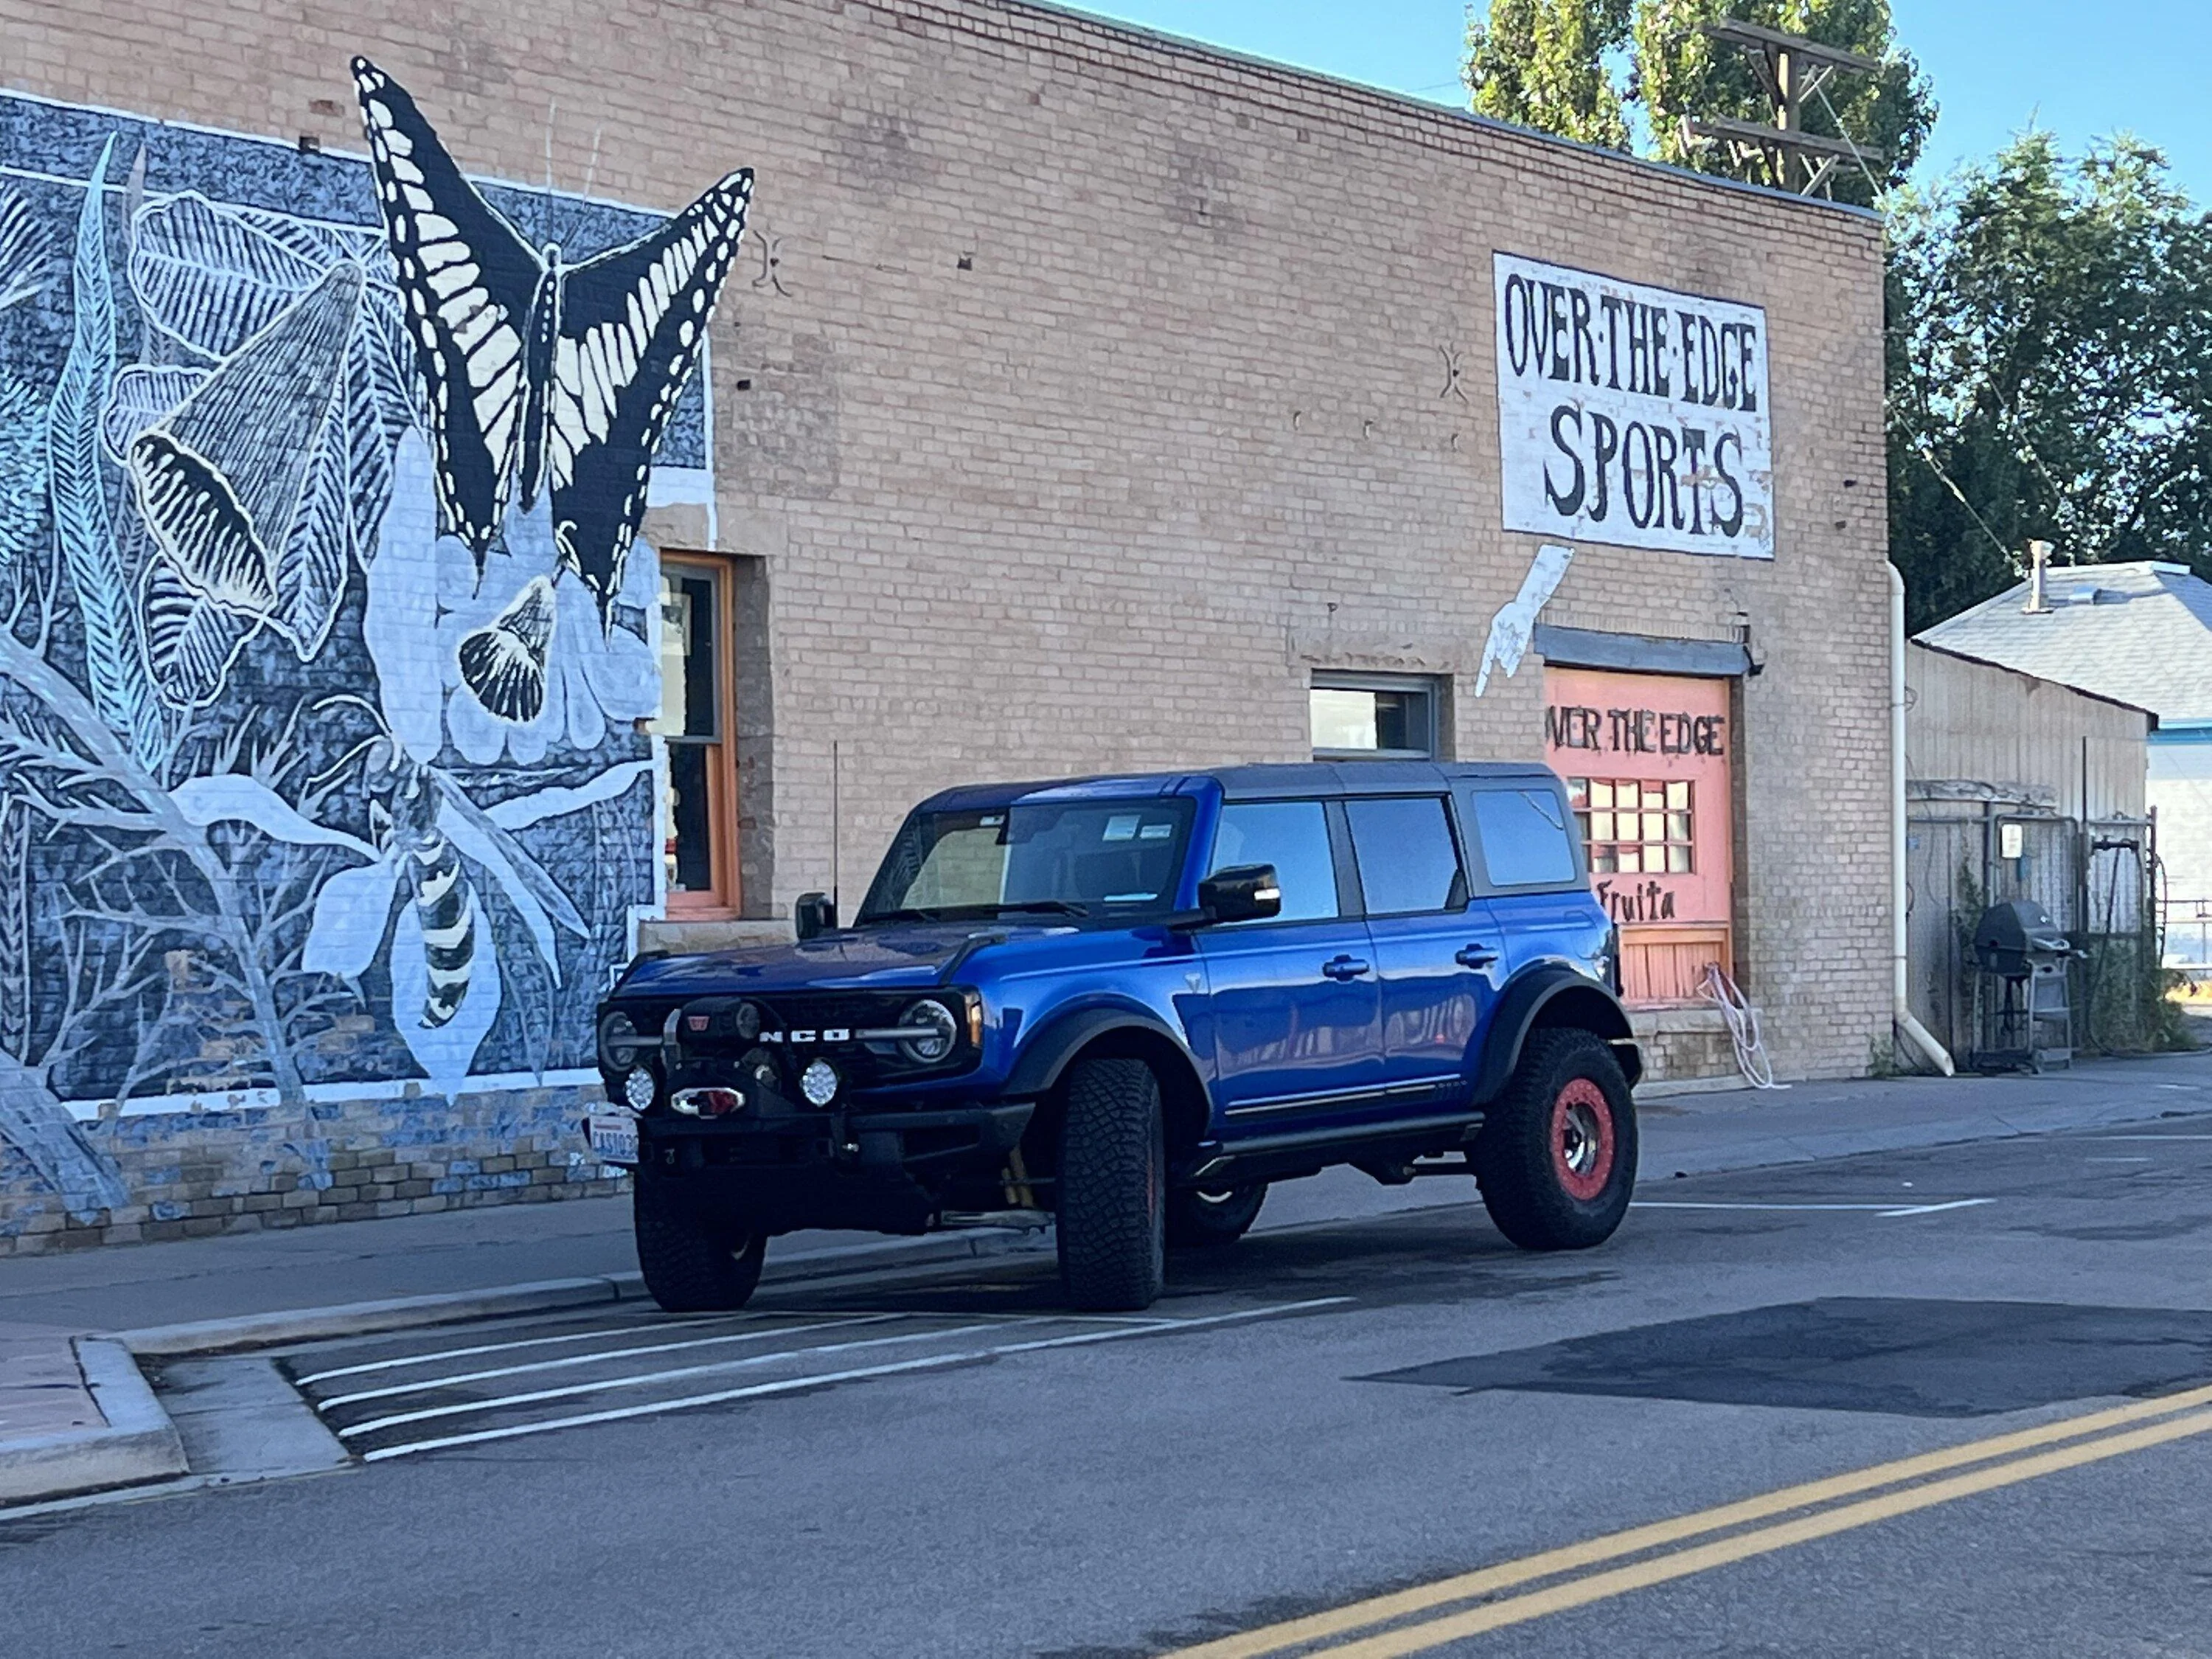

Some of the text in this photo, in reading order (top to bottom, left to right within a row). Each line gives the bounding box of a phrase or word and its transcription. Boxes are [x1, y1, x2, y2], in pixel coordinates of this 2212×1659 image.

[1506, 273, 1757, 412] OVER THE EDGE
[1544, 398, 1744, 538] SPORTS
[1545, 705, 1725, 756] VER THE EDGE
[1597, 879, 1675, 922] Fruita
[759, 1029, 850, 1043] NCO
